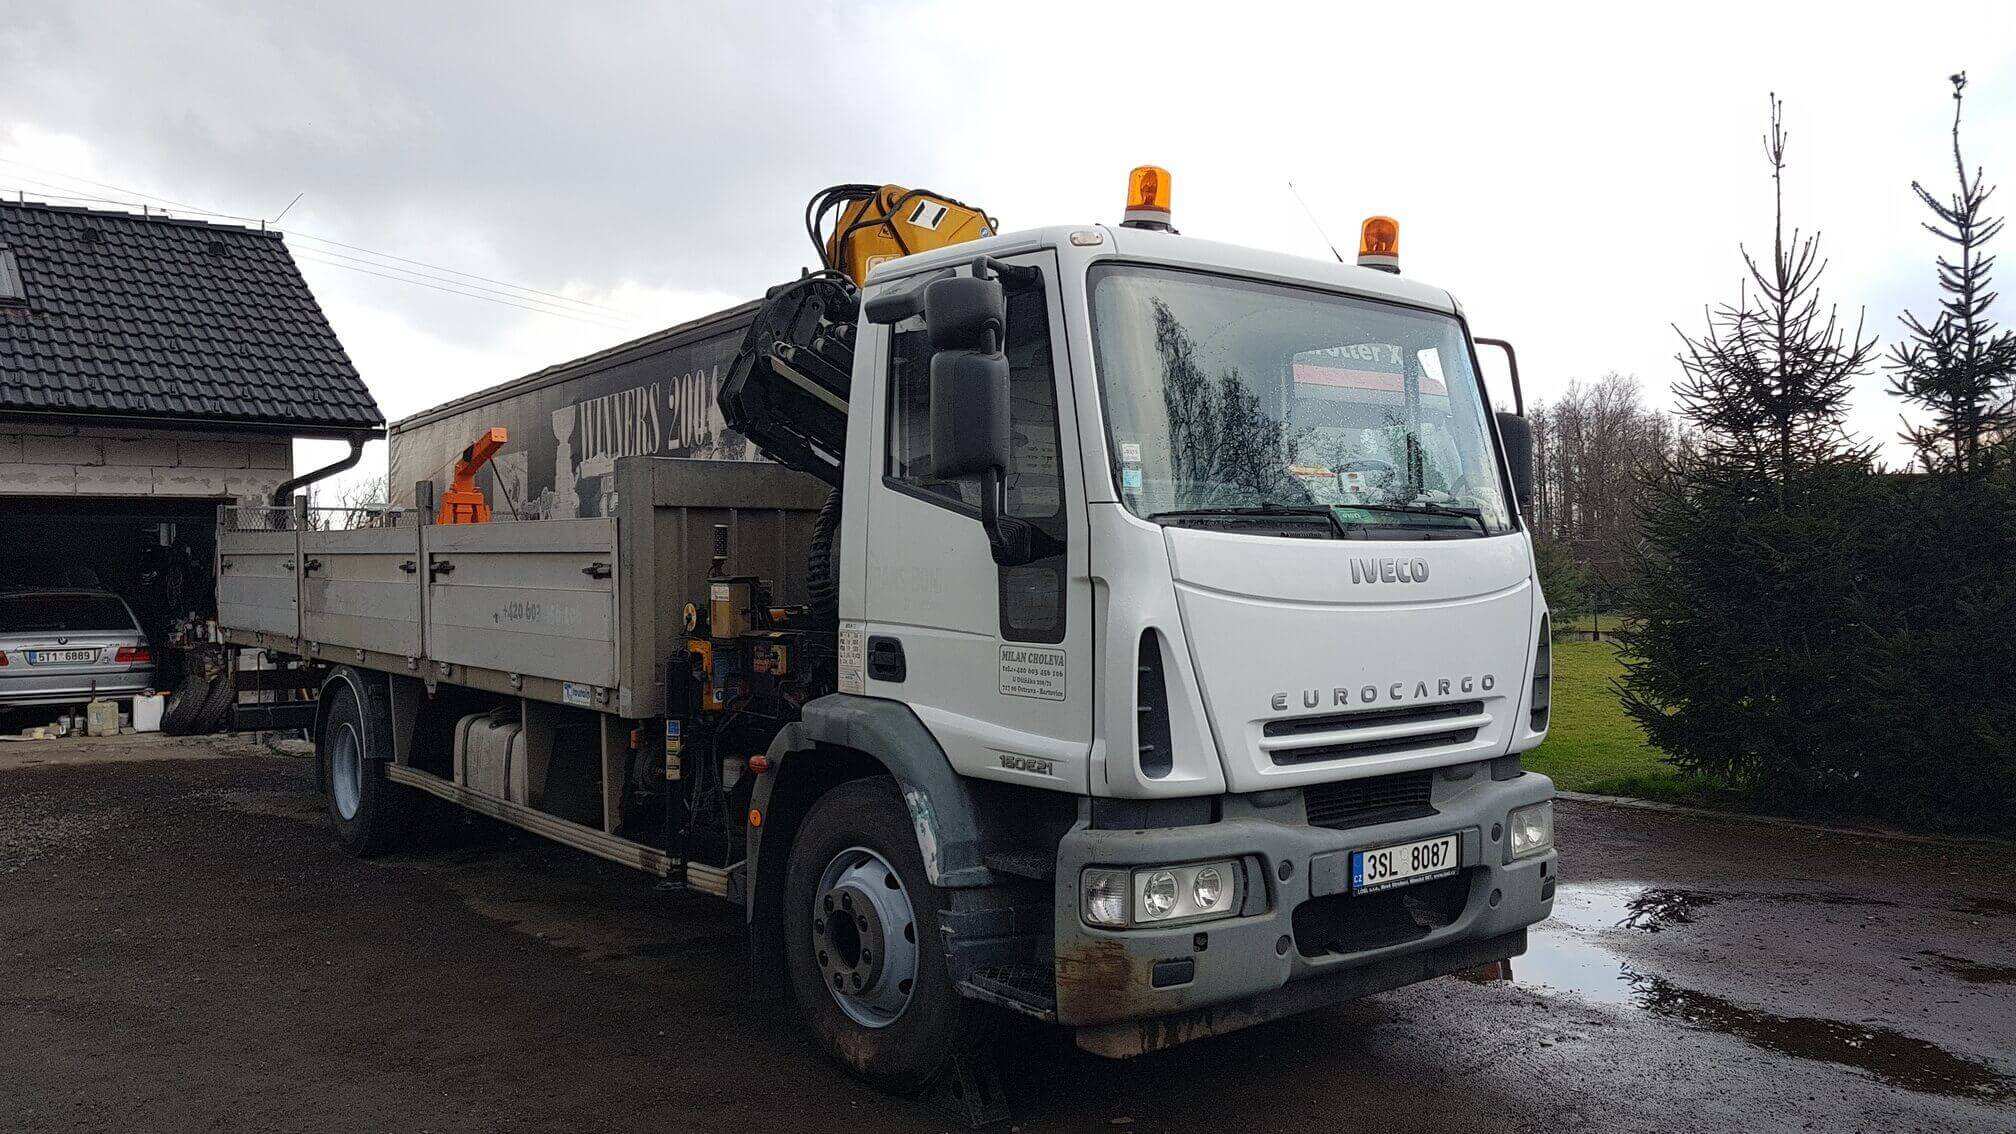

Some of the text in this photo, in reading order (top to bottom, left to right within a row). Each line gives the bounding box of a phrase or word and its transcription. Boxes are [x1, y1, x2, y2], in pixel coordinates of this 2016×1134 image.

[1350, 557, 1430, 585] IVECO
[1001, 650, 1065, 667] MILAN CHOLEVA
[1270, 673, 1496, 711] EUROCARGO
[1367, 850, 1399, 880] 3SL
[1411, 840, 1450, 872] 8087
